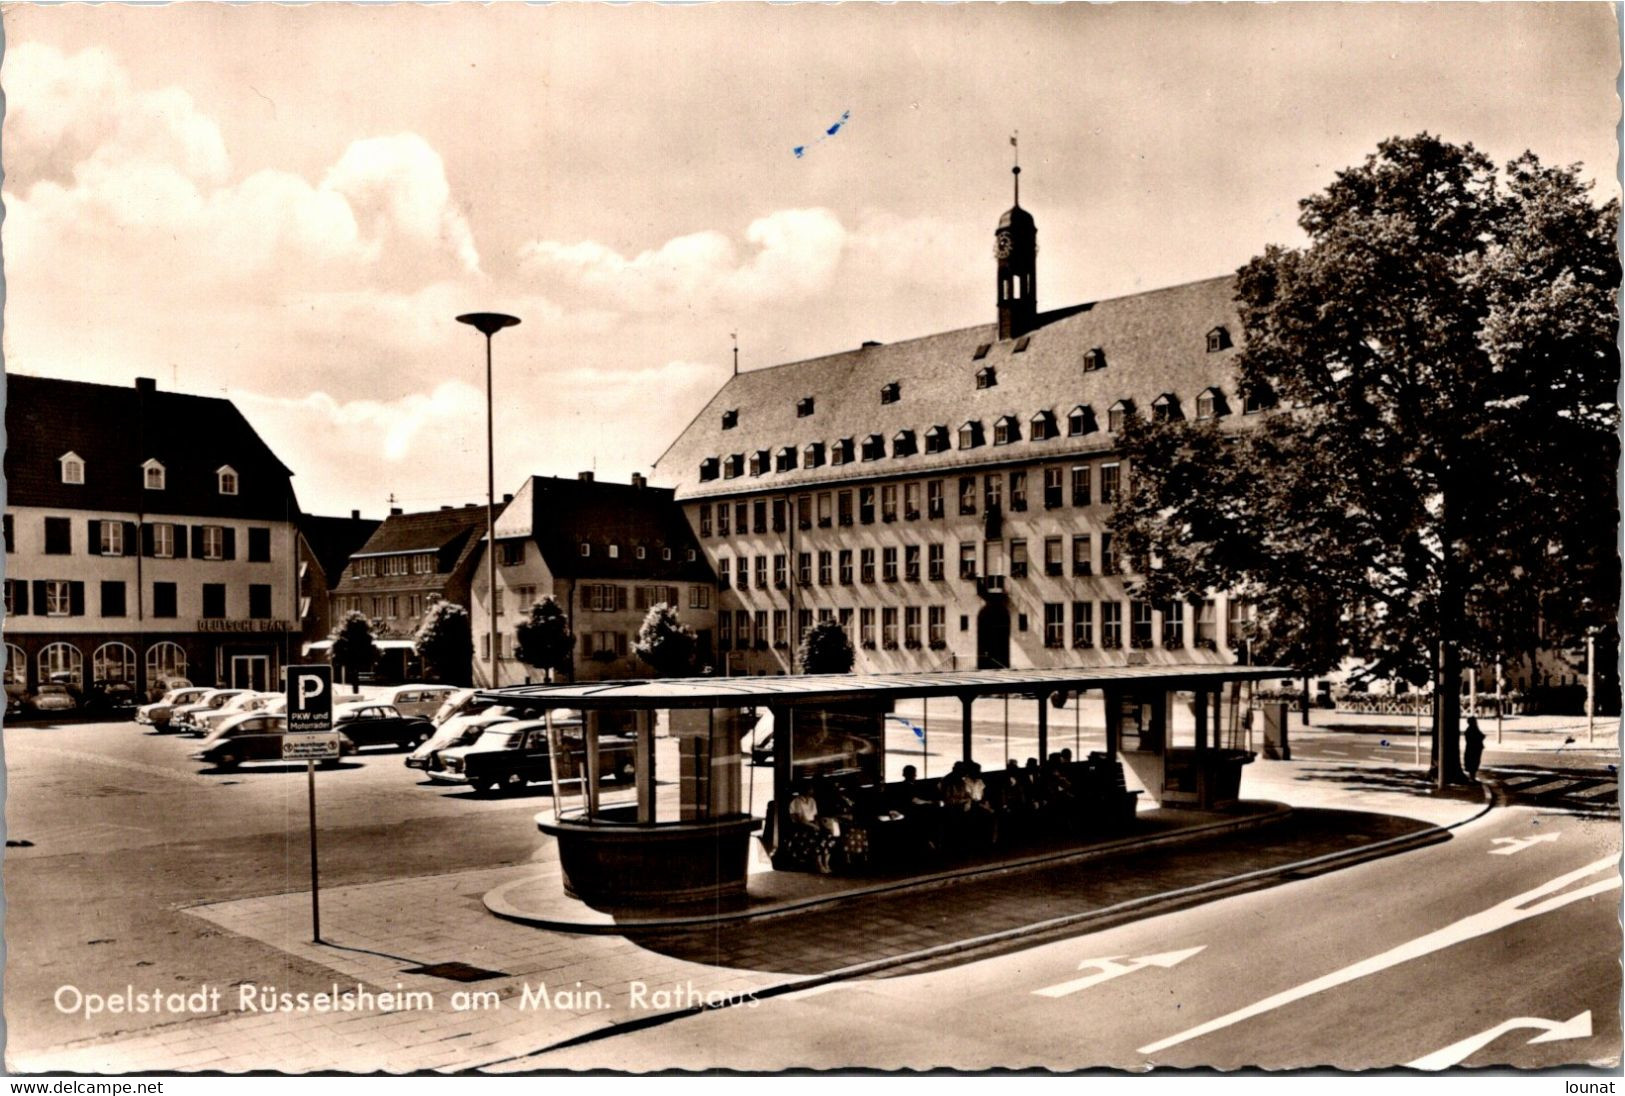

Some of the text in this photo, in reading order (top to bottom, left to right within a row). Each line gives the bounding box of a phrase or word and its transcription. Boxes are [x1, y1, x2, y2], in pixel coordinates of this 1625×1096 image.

[197, 619, 294, 632] DEUTSCHE BANK
[298, 674, 325, 710] P
[291, 711, 329, 721] PKW und
